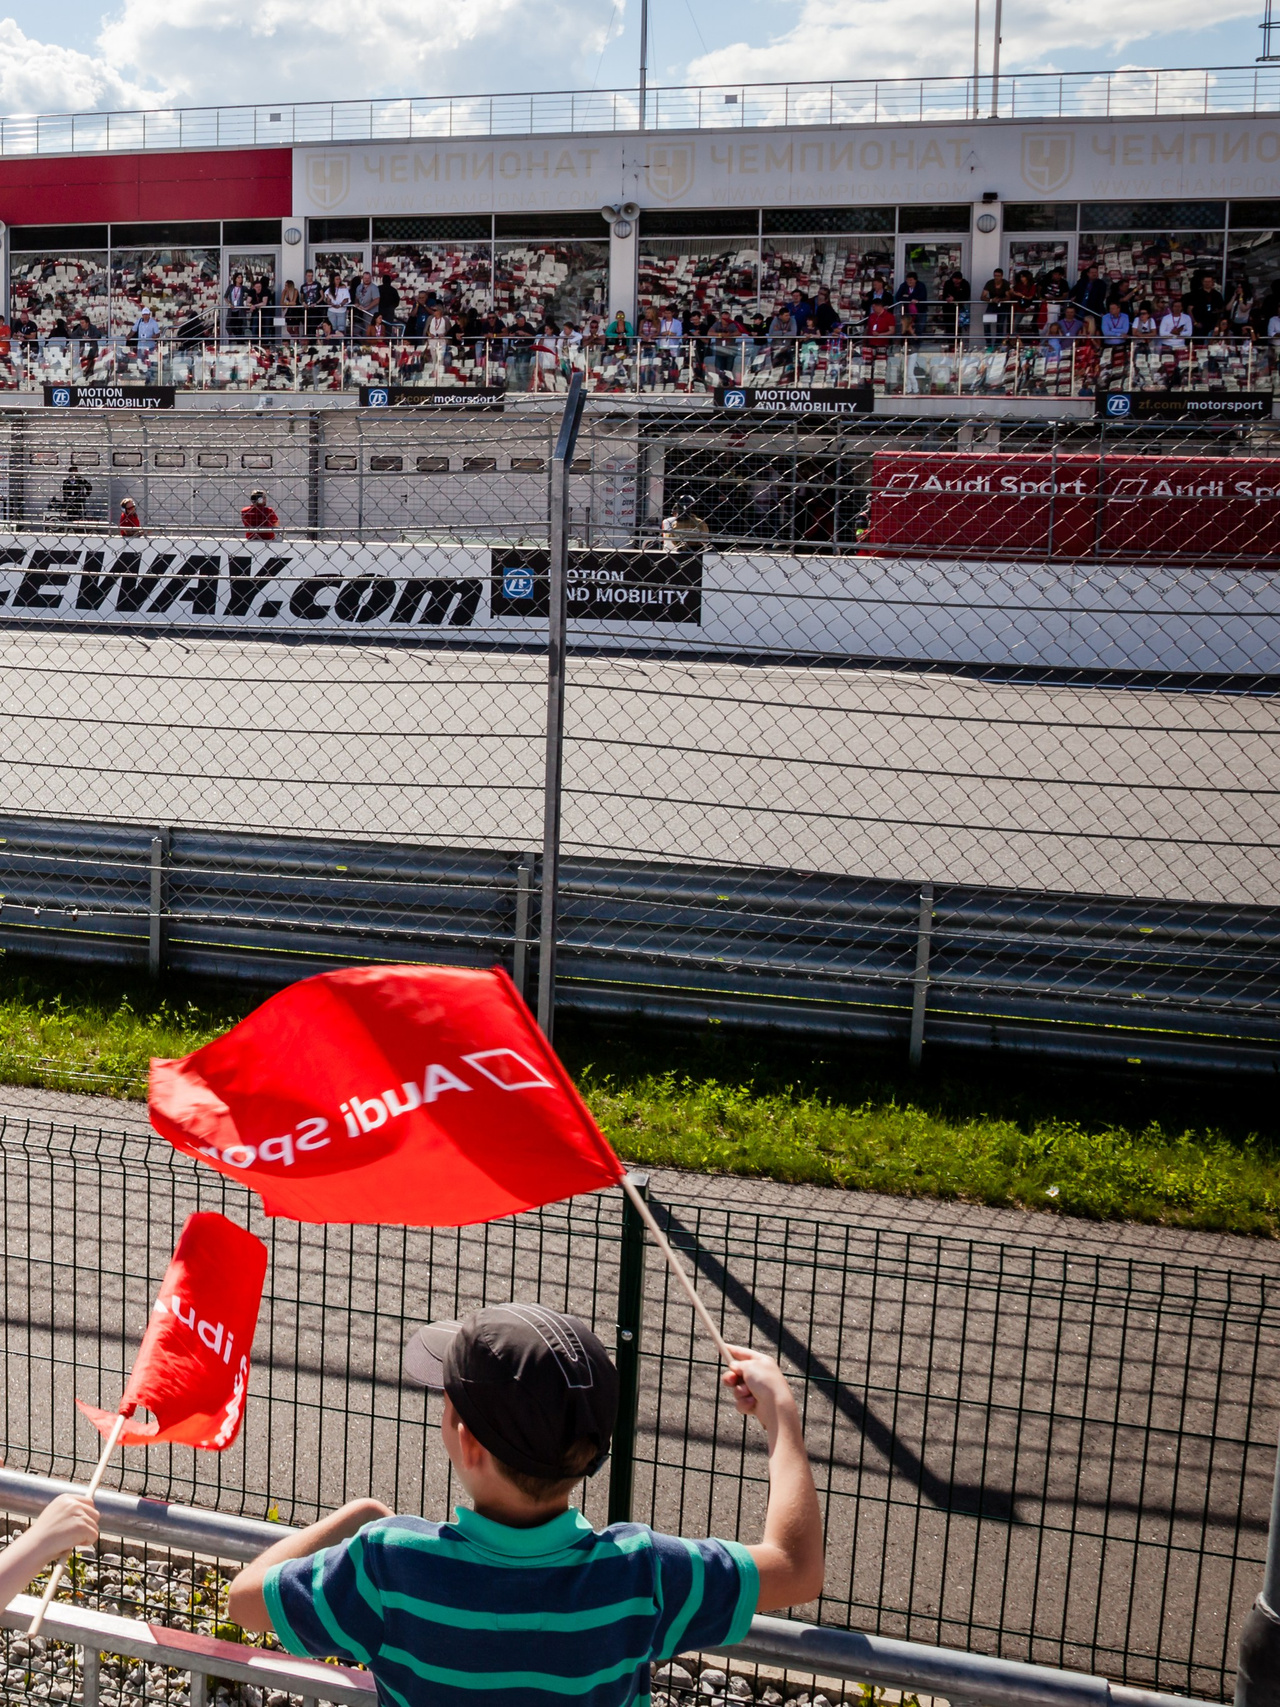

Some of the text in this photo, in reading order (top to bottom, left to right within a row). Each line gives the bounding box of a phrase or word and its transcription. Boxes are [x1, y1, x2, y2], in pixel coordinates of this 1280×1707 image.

[710, 138, 970, 174] ЧЕМПИОНАТ
[364, 149, 600, 184] ЧЕМПИОНАТ
[365, 190, 598, 210] WWW.CHAMPIONAT.COM
[711, 182, 968, 201] WWW.CHAMPIONAT.COM
[77, 388, 123, 398] MOTION
[755, 390, 811, 401] MOTION
[79, 398, 161, 408] AND MOBILITY
[757, 402, 857, 412] AND MOBILITY
[1138, 399, 1263, 412] zf.com/motorsport
[922, 475, 1087, 500] Audi Sport
[1153, 480, 1280, 504] Audi Sp
[548, 569, 624, 583] OTION
[596, 588, 690, 605] MOBILITY
